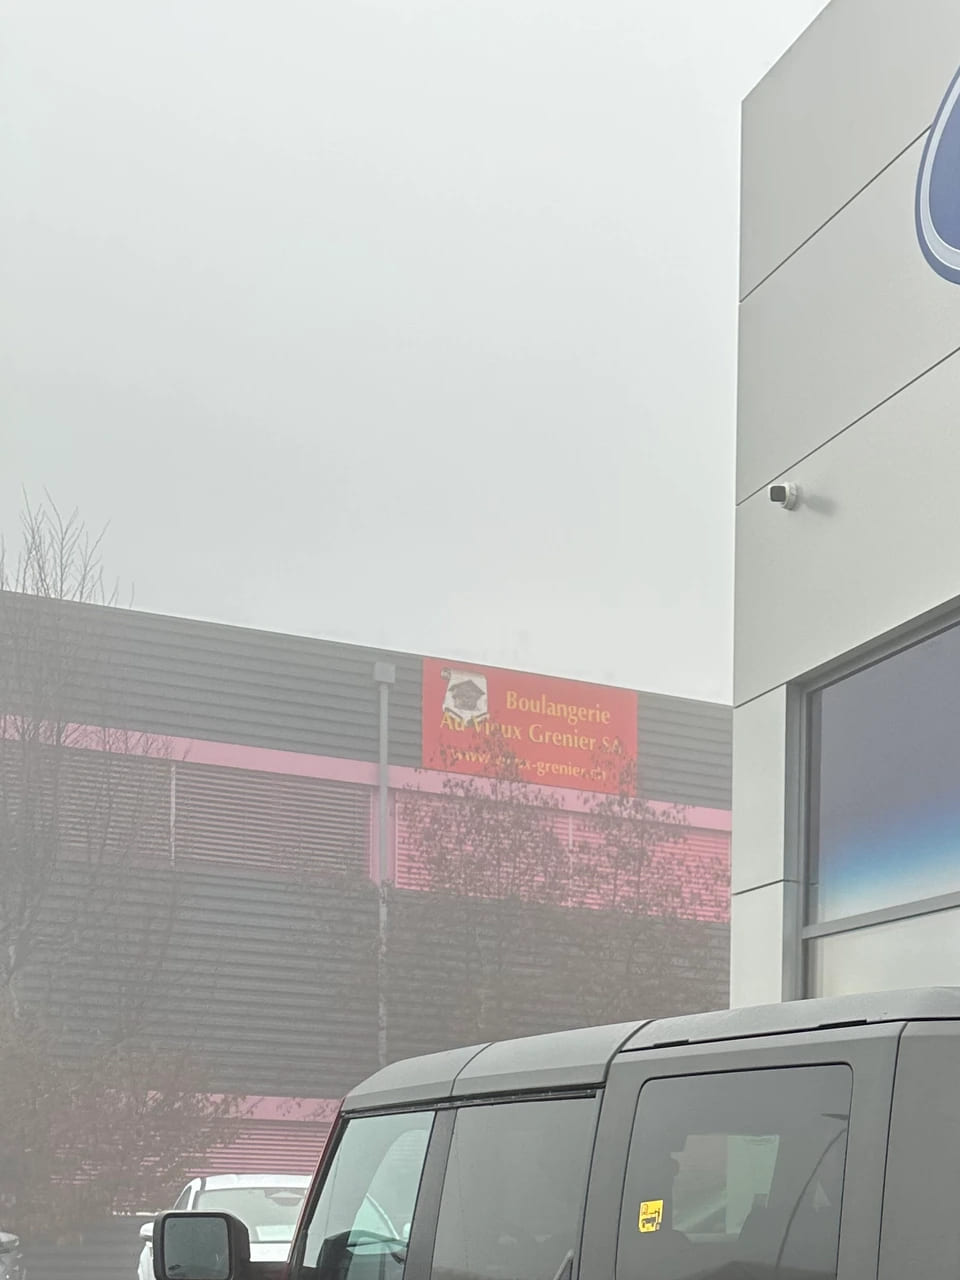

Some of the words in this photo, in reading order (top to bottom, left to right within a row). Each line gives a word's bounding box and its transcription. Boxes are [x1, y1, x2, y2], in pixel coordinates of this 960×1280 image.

[506, 690, 611, 725] Boulangerie
[440, 711, 465, 731] Au
[528, 723, 597, 750] Grenier
